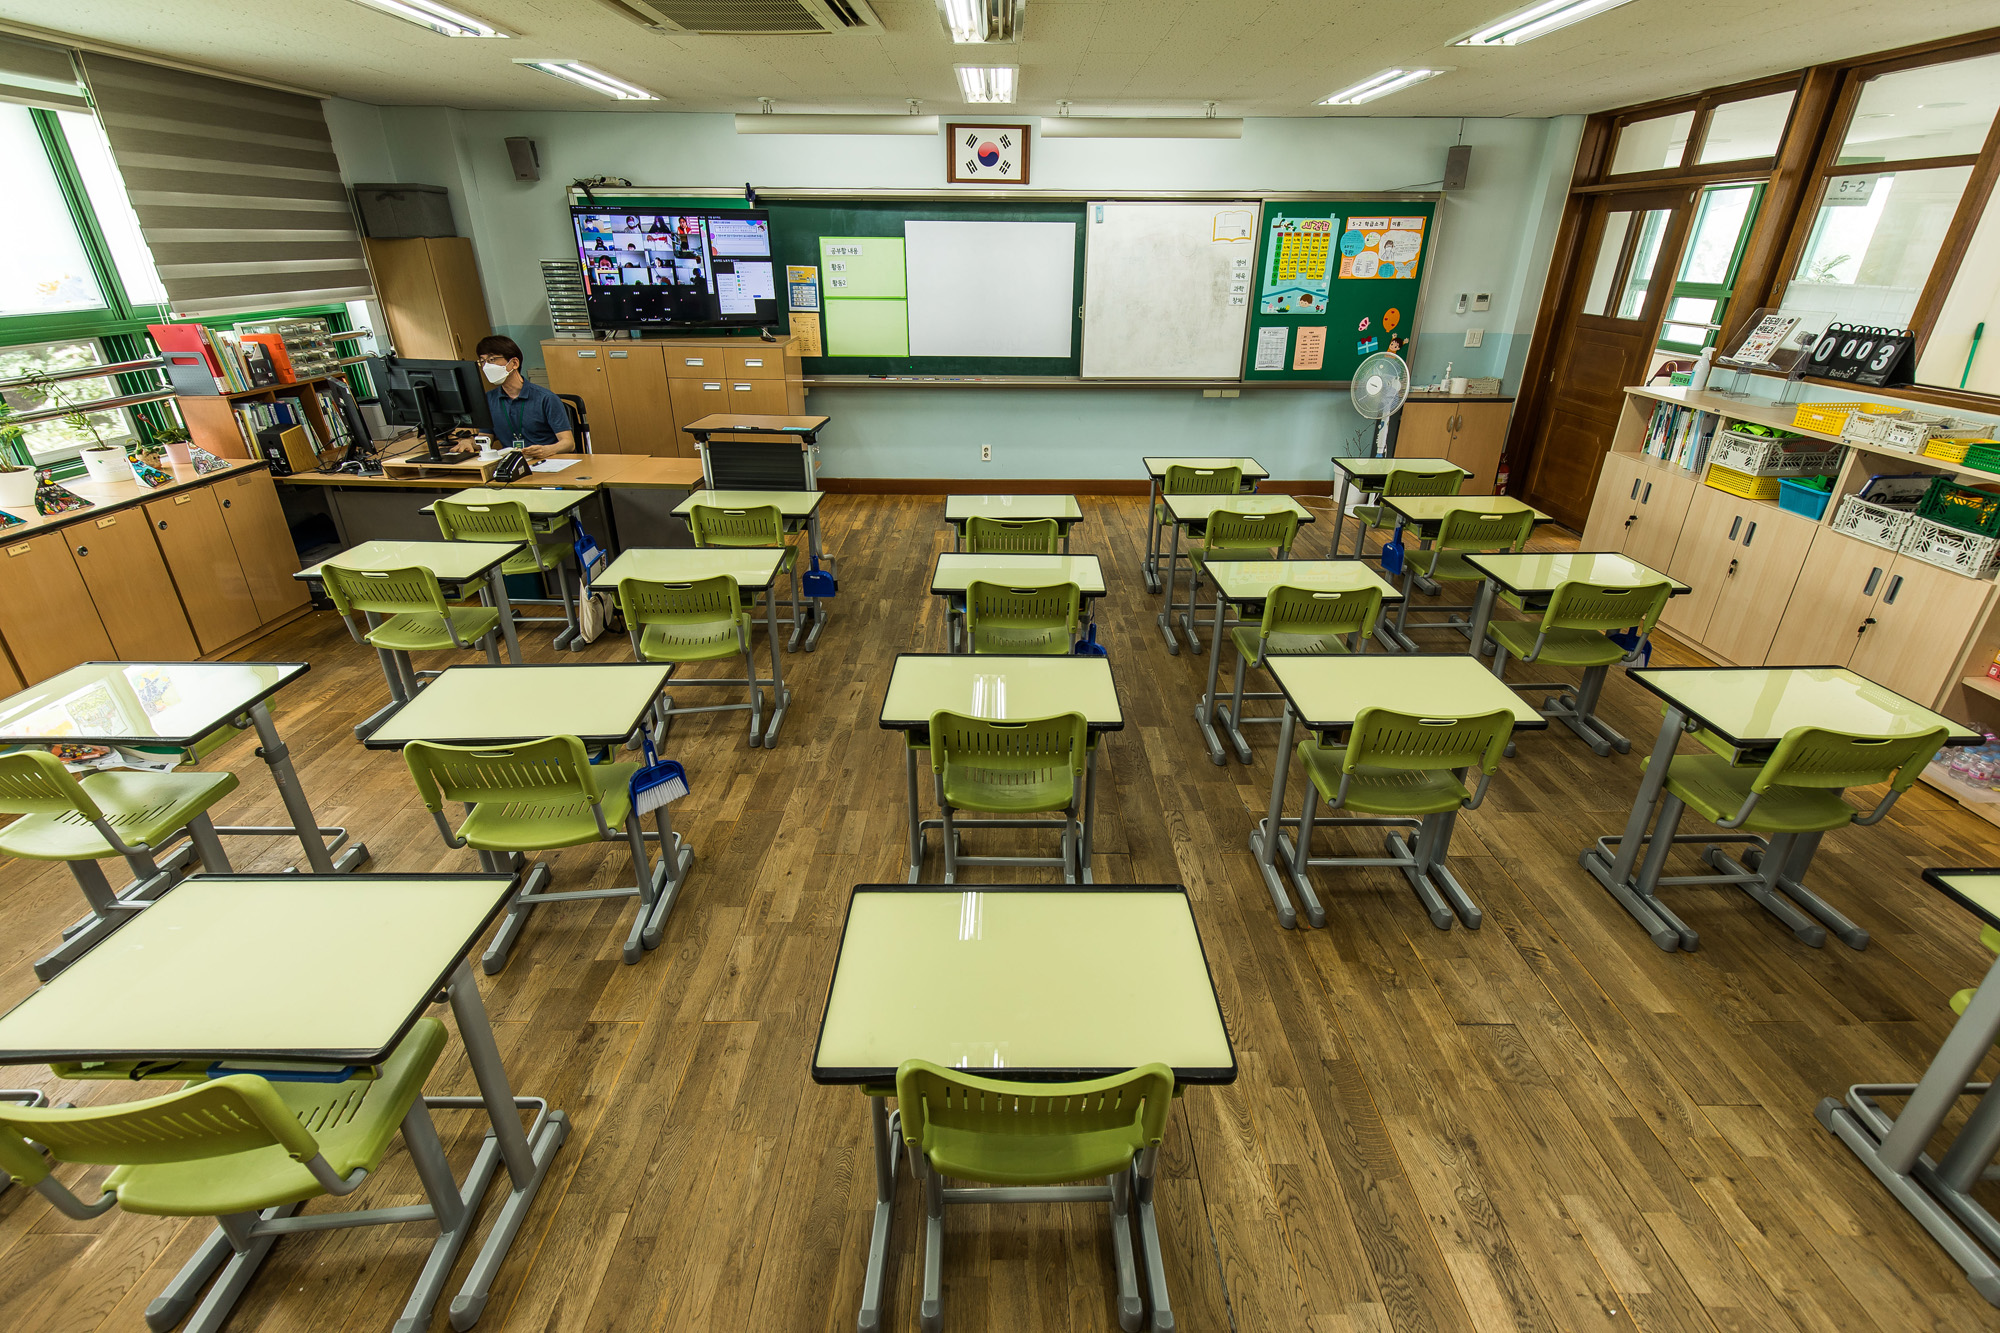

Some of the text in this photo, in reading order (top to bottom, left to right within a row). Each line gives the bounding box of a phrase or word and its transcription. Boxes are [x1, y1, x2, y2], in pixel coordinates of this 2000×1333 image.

[1840, 180, 1866, 193] 5-2
[830, 247, 859, 255] 공부할 내용
[831, 263, 845, 271] 활동1
[832, 279, 847, 287] 활동2
[1233, 285, 1245, 293] 과학
[1814, 337, 1836, 362] 0
[1870, 344, 1895, 371] 3
